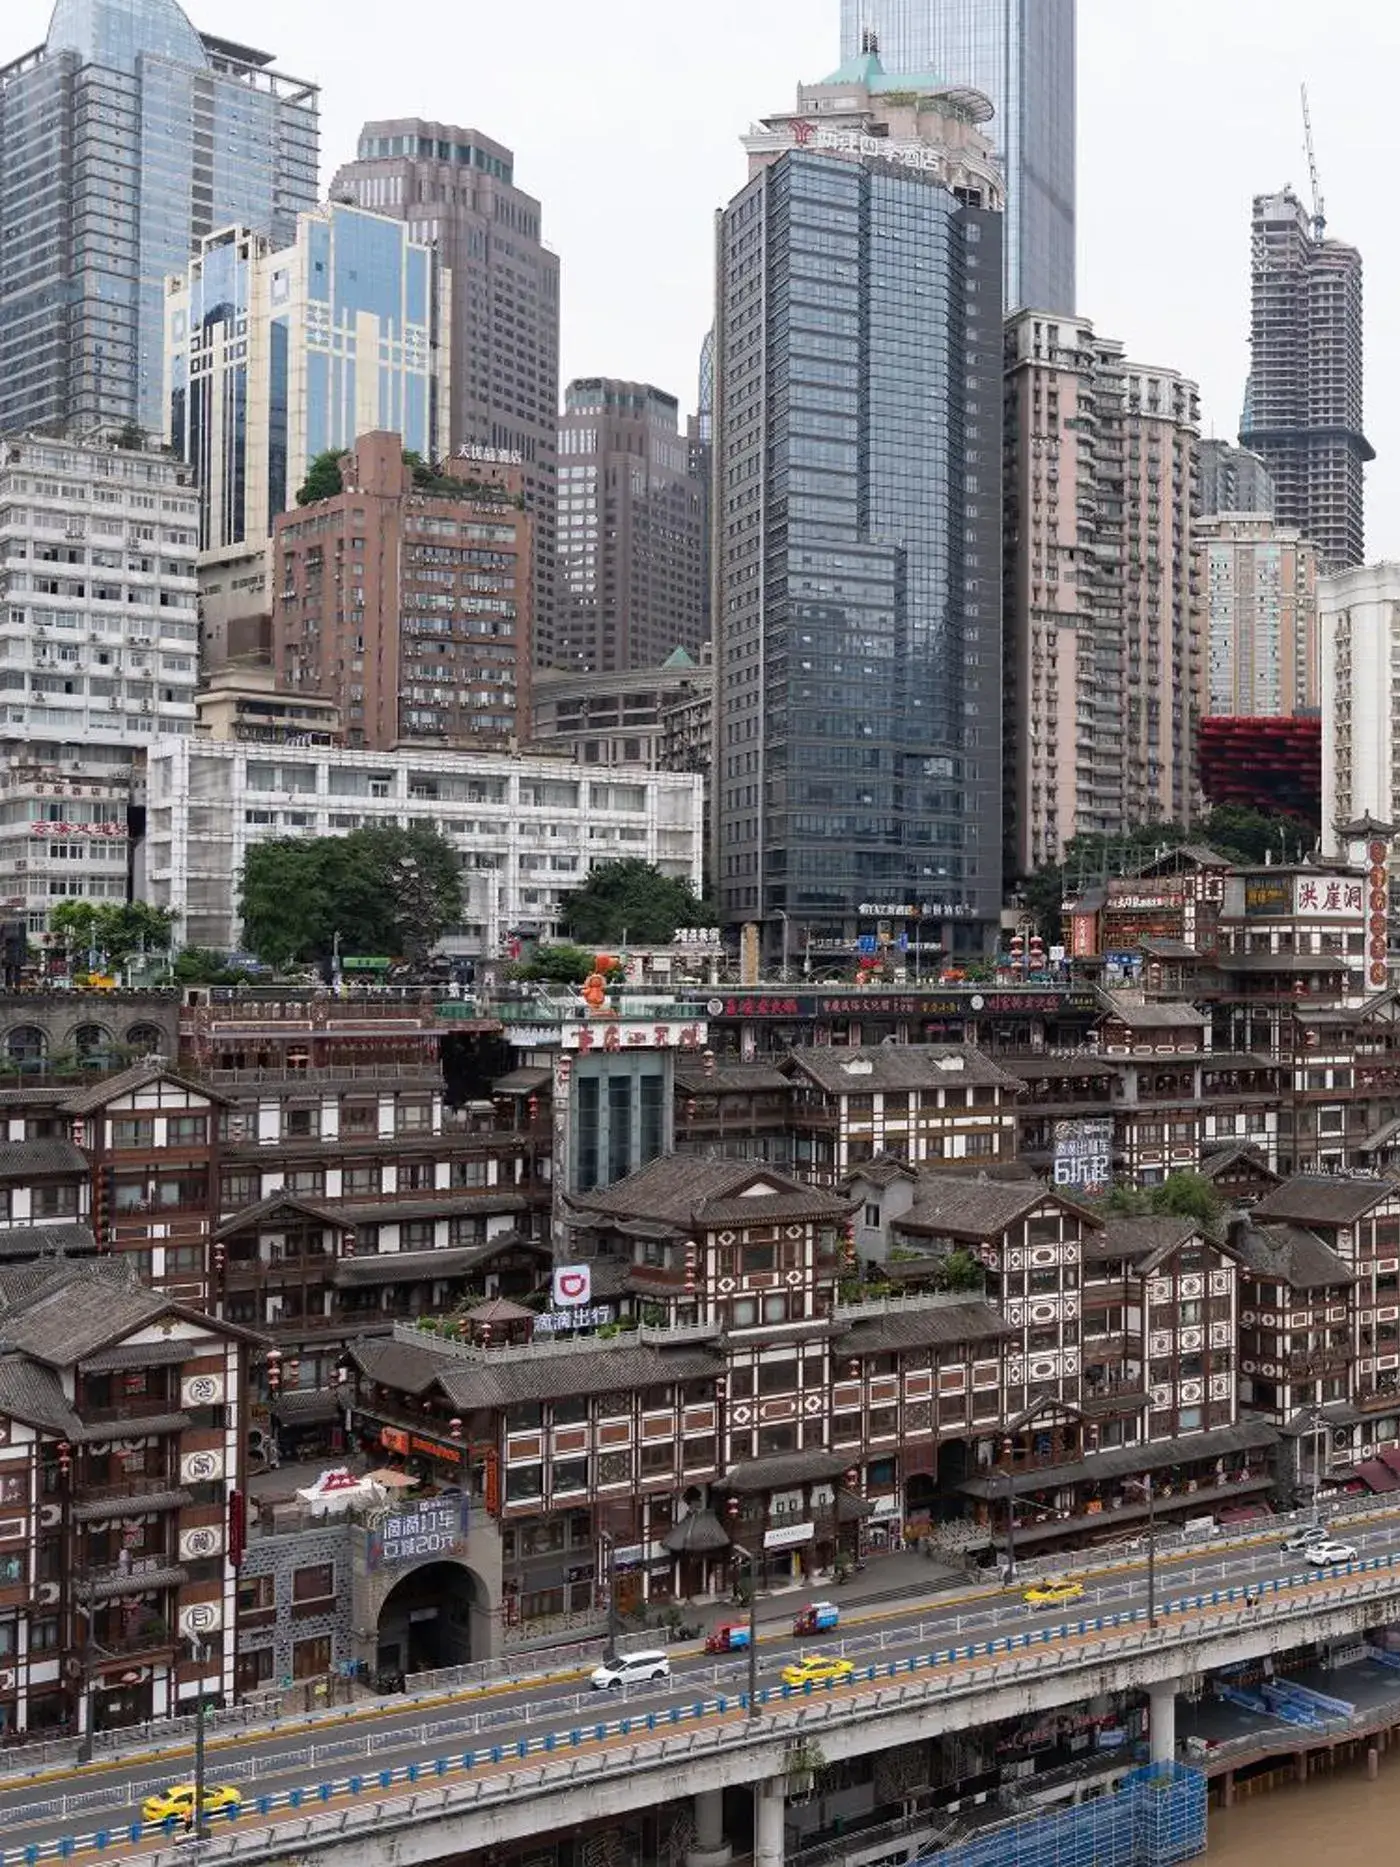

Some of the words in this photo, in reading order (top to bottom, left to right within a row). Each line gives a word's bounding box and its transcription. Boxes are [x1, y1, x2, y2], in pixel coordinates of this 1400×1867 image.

[1299, 881, 1362, 912] 洪崖洞
[1054, 1155, 1109, 1184] 6折起
[533, 1304, 610, 1332] 滴滴出行
[383, 1509, 454, 1540] 滴滴打车
